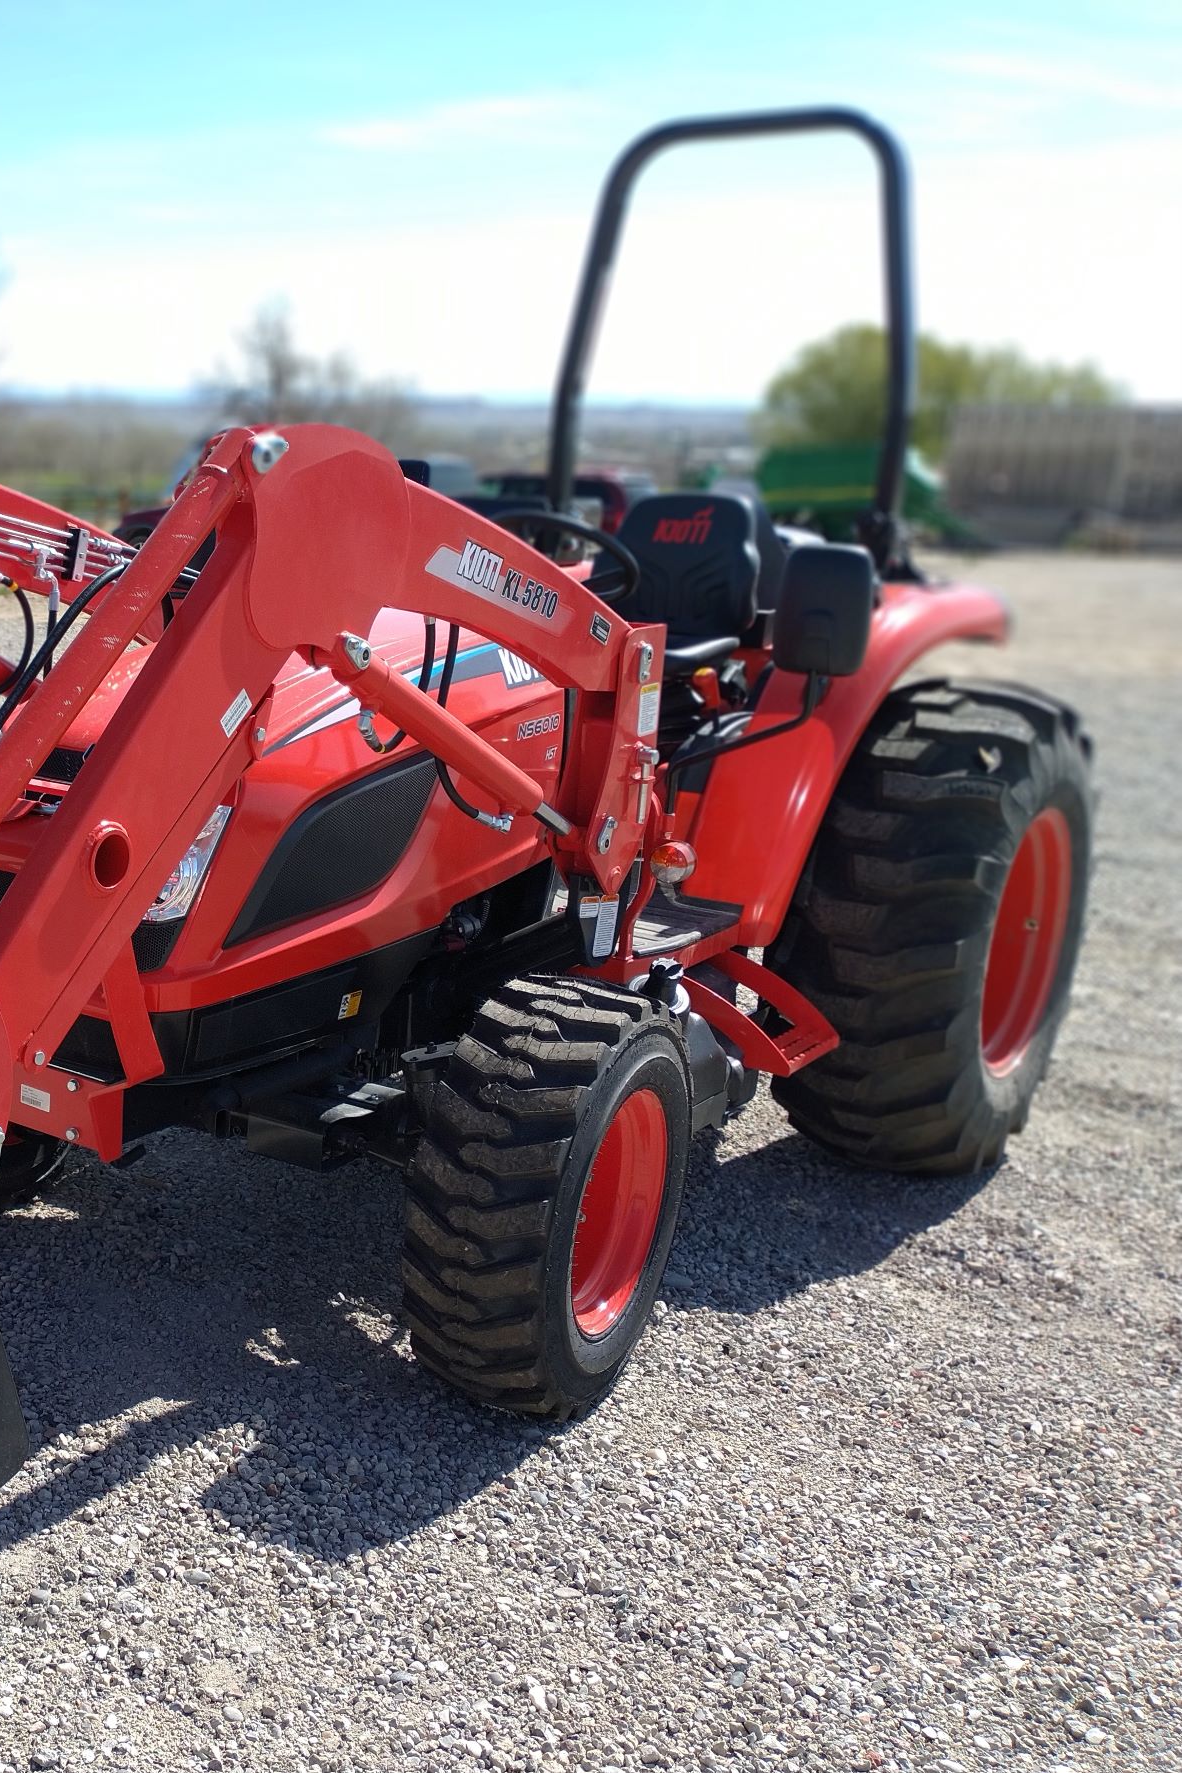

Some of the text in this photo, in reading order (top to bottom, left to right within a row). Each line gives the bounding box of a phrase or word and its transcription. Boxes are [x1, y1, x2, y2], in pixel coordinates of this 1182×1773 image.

[652, 507, 714, 545] KIOTI
[457, 540, 560, 620] KIOTI KL 5810
[498, 649, 540, 685] KIO
[516, 713, 561, 741] NS6010
